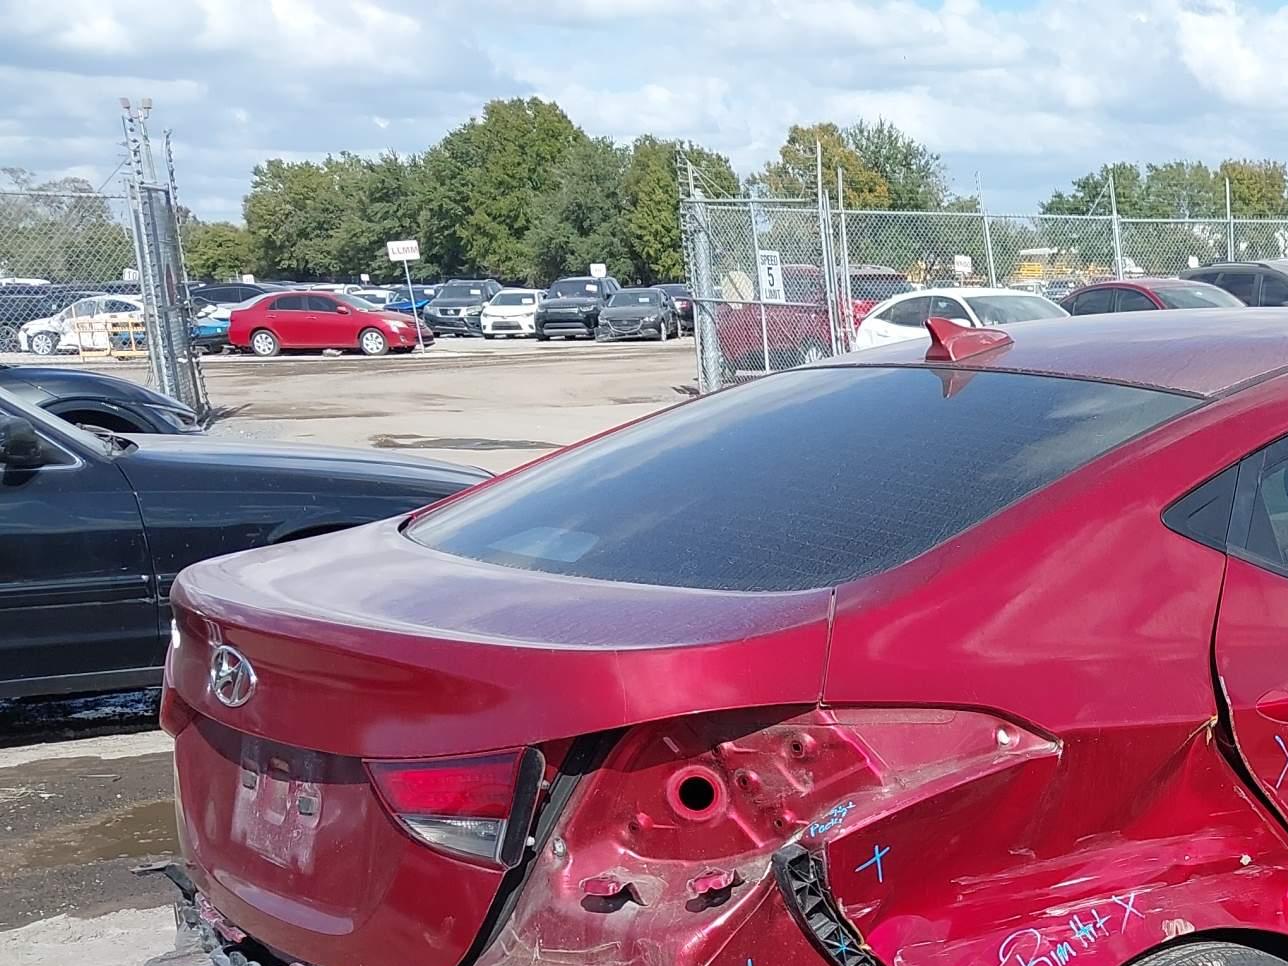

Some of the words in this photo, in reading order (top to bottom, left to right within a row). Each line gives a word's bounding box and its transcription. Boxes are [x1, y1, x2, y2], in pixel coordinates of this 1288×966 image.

[760, 255, 778, 266] SPEED
[767, 267, 775, 287] 5
[765, 289, 781, 300] LIMIT
